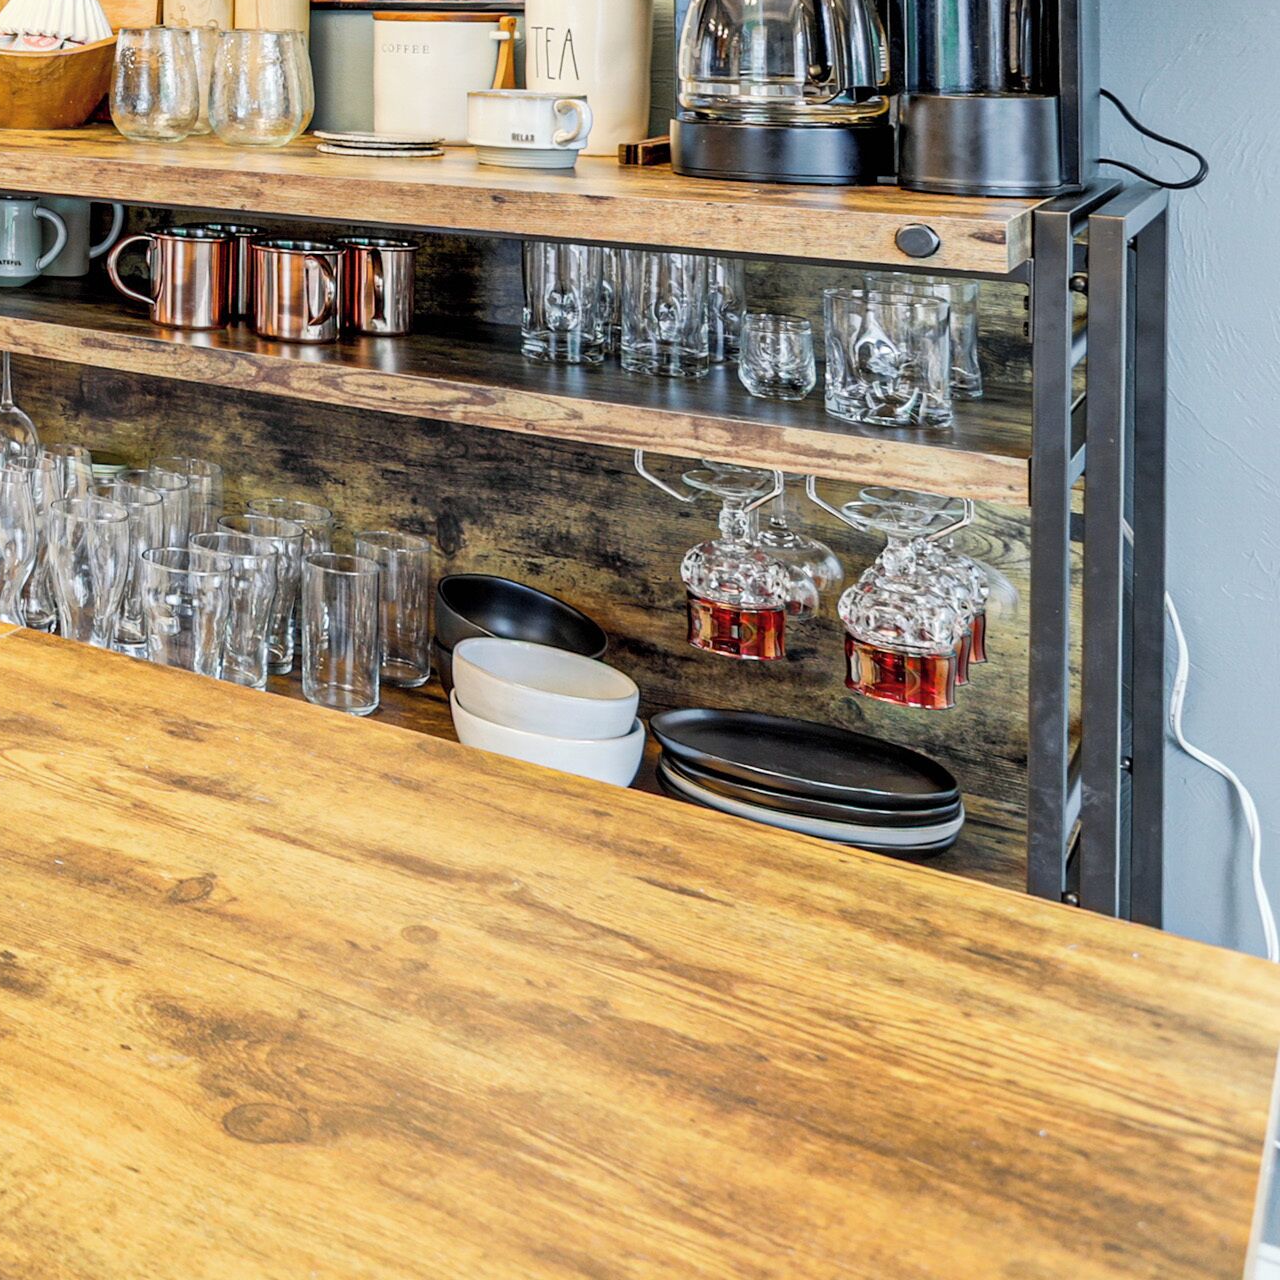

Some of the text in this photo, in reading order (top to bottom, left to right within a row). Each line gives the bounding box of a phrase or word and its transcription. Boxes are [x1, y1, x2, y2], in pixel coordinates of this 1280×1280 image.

[380, 43, 431, 55] COFFEE
[530, 26, 580, 81] TEA
[511, 132, 535, 143] RELAX
